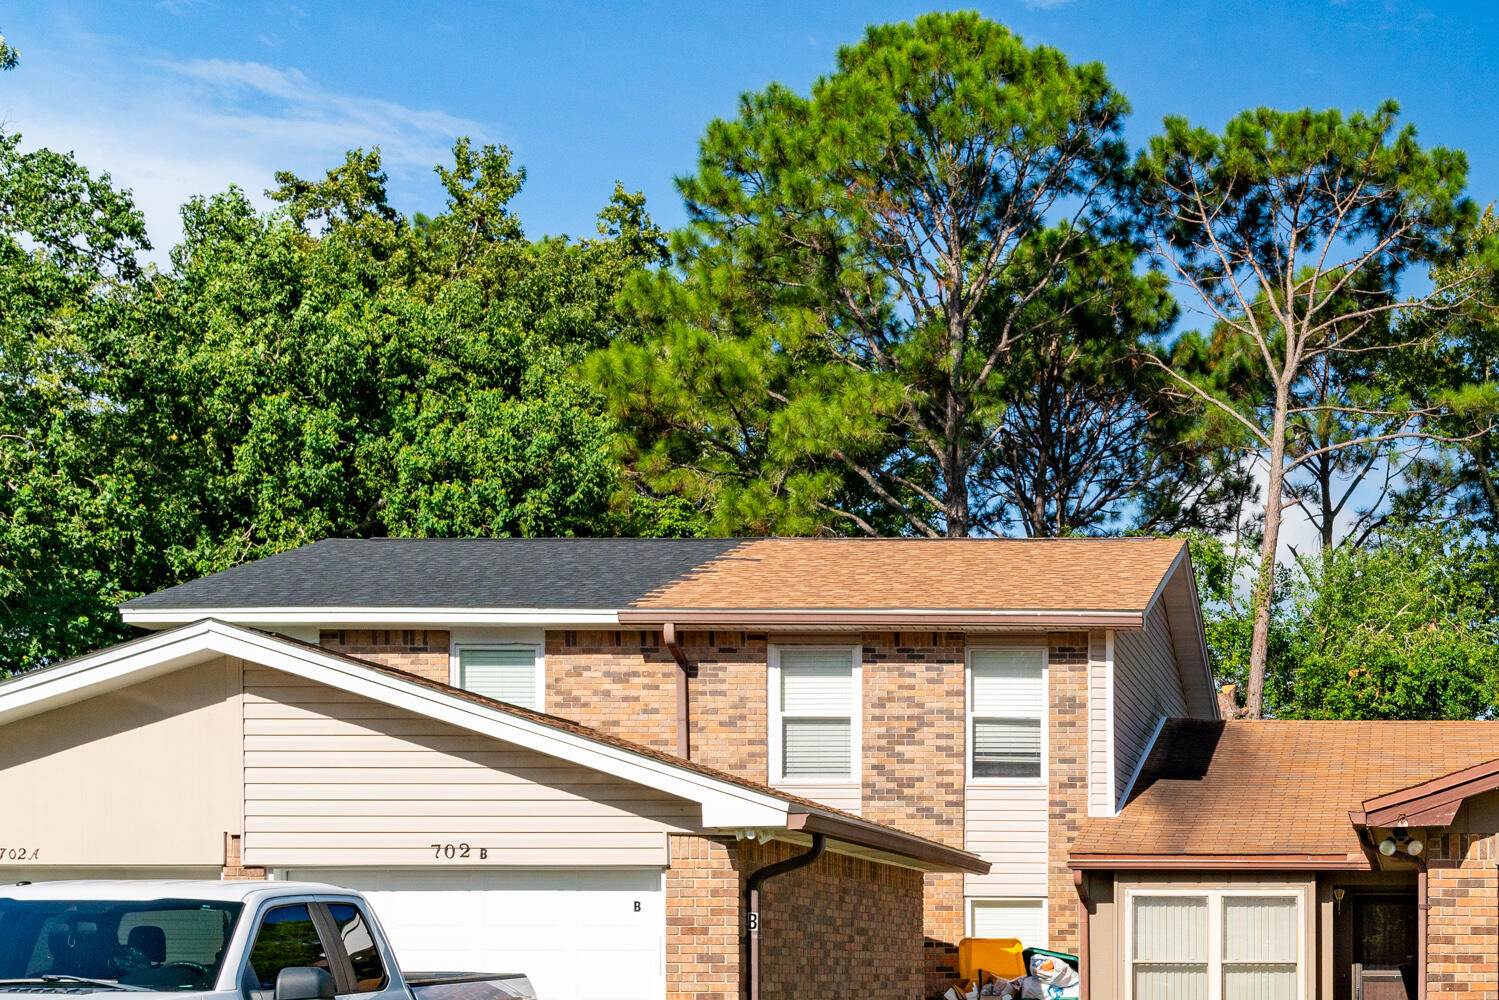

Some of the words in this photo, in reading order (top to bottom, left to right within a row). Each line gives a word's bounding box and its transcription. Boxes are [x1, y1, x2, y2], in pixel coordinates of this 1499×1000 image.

[430, 843, 470, 859] 702
[480, 848, 487, 859] B
[633, 901, 641, 912] B
[748, 914, 758, 930] B
